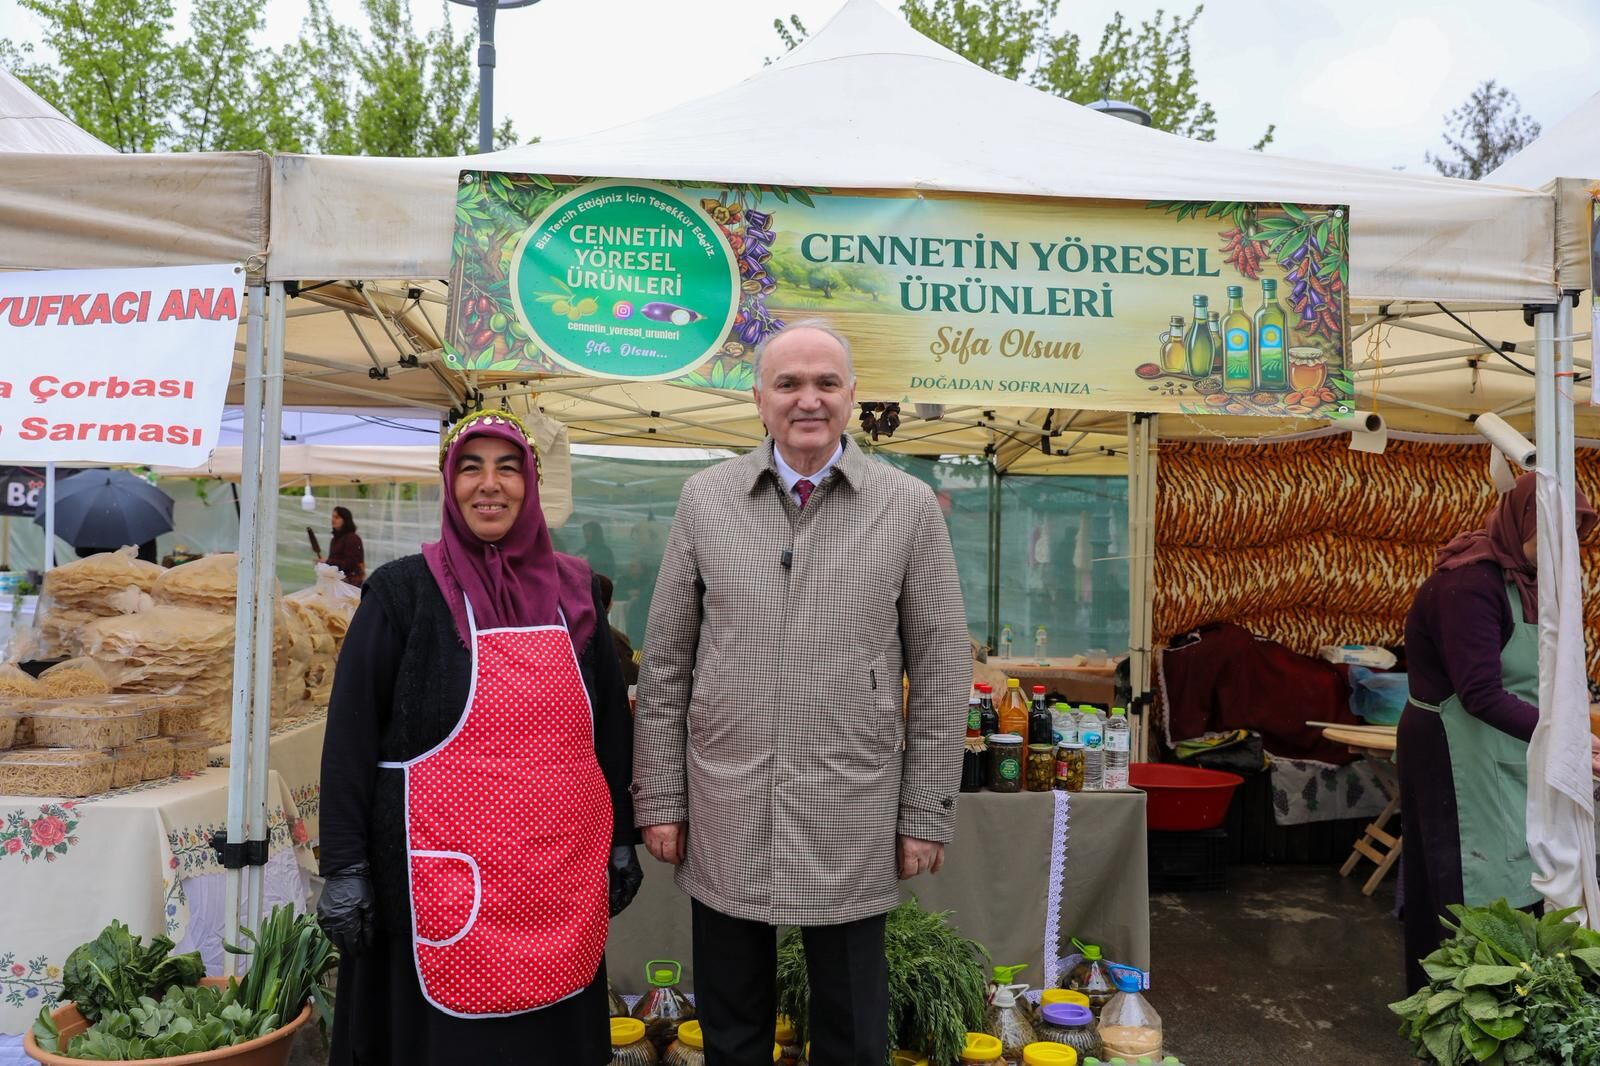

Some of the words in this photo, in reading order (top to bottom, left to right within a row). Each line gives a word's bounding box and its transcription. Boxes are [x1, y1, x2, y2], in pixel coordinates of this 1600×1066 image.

[536, 232, 552, 250] Bizi
[549, 210, 577, 233] Tercih
[577, 193, 623, 212] Ettiğiniz
[569, 224, 682, 248] CENNETİN
[574, 246, 677, 273] YÖRESEL
[801, 232, 1020, 271] CENNETİN
[1029, 236, 1221, 278] YÖRESEL
[567, 265, 682, 297] ÜRÜNLERİ
[899, 274, 1115, 319] ÜRÜNLERİ
[158, 287, 238, 323] ANA
[929, 326, 993, 365] Şifa
[999, 328, 1084, 361] Olsun
[29, 375, 195, 404] Çorbası
[910, 375, 995, 392] DOĞADAN
[997, 378, 1092, 396] SOFRANIZA
[18, 416, 203, 447] Sarması
